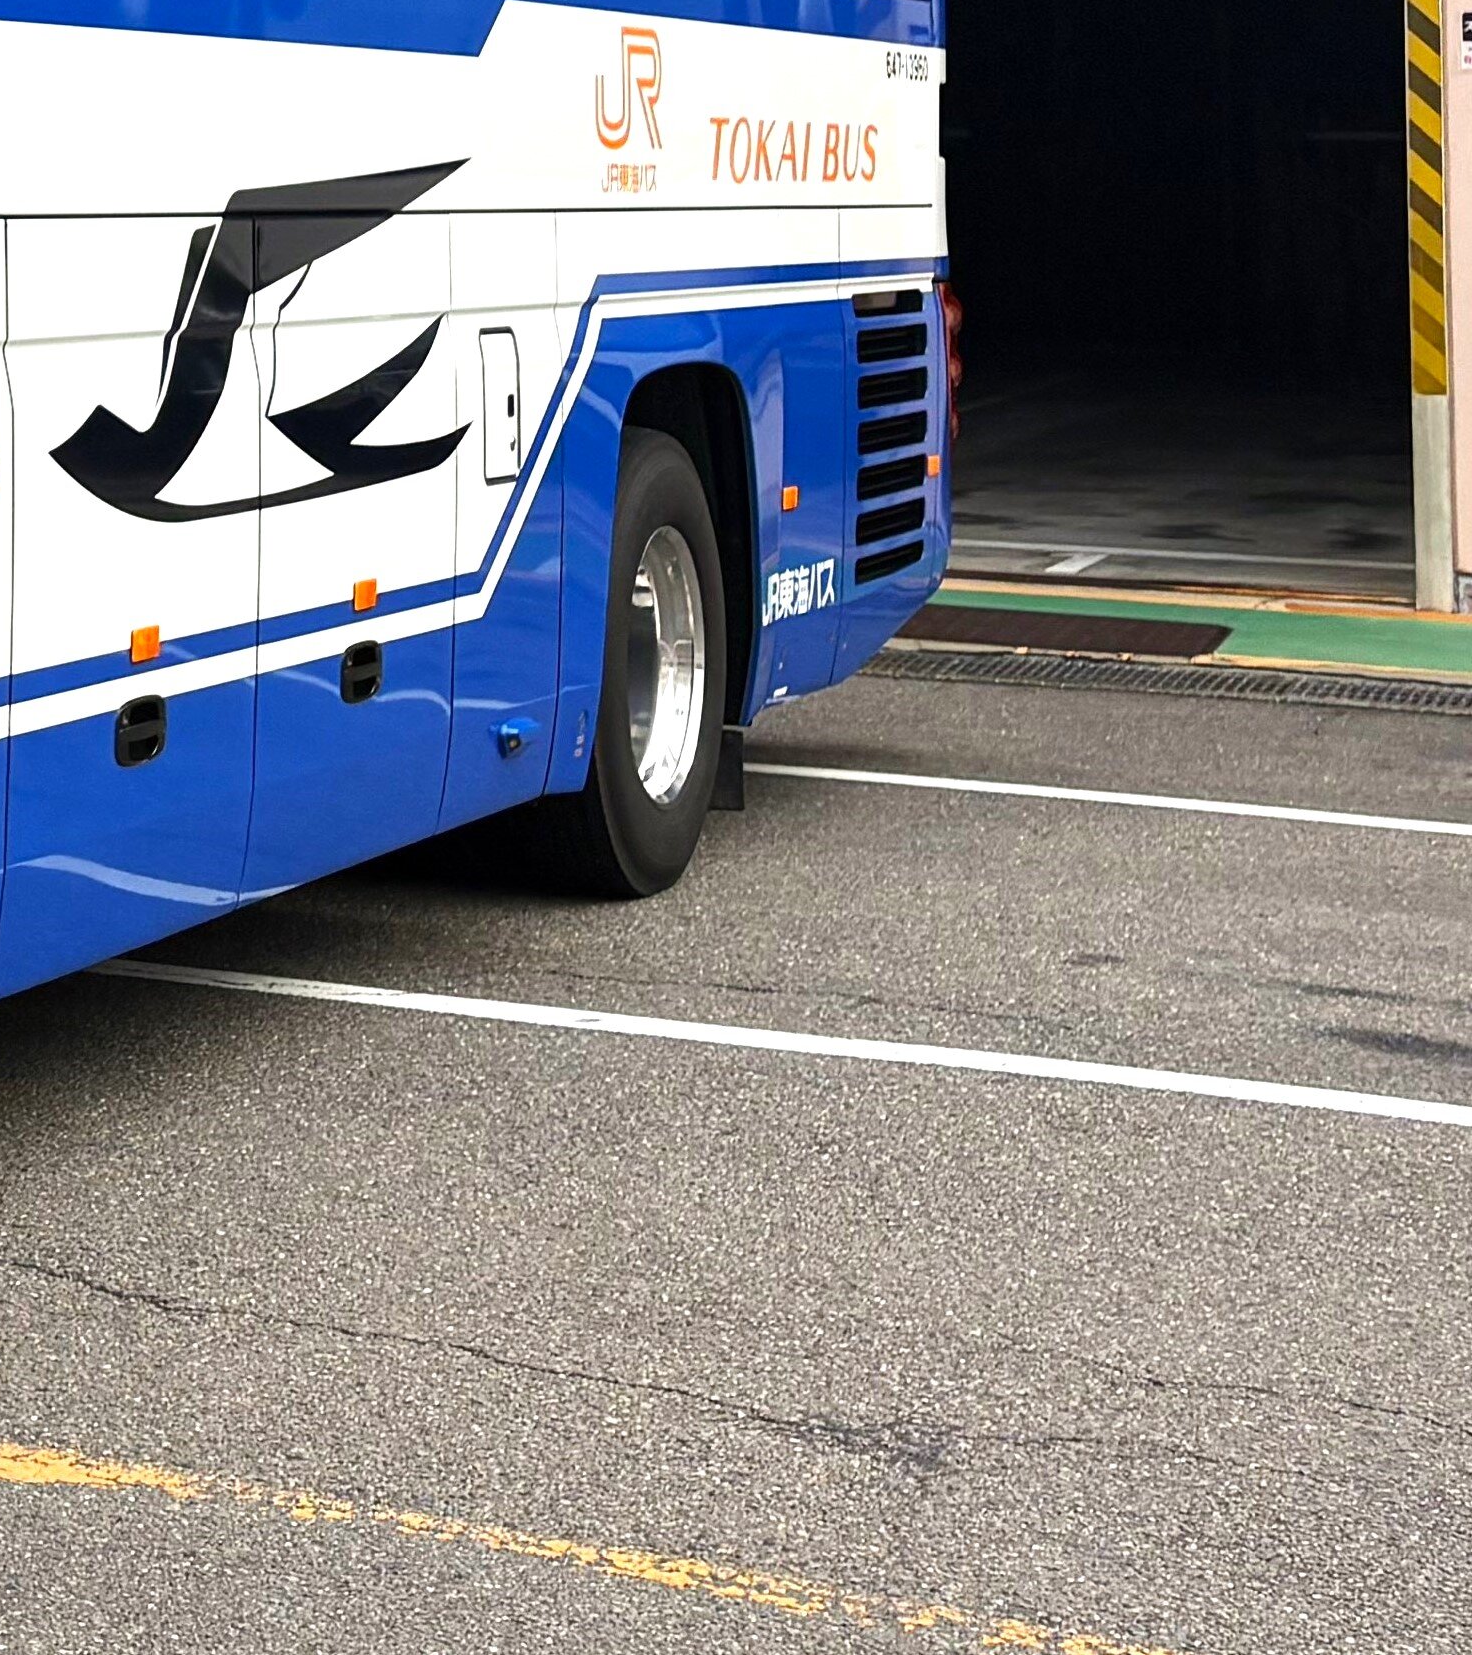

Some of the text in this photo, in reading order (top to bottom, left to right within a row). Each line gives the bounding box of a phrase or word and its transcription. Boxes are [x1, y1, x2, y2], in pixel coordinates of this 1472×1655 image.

[595, 26, 662, 150] JR
[709, 116, 879, 184] TOKAI BUS
[762, 557, 835, 627] JR東海バス
